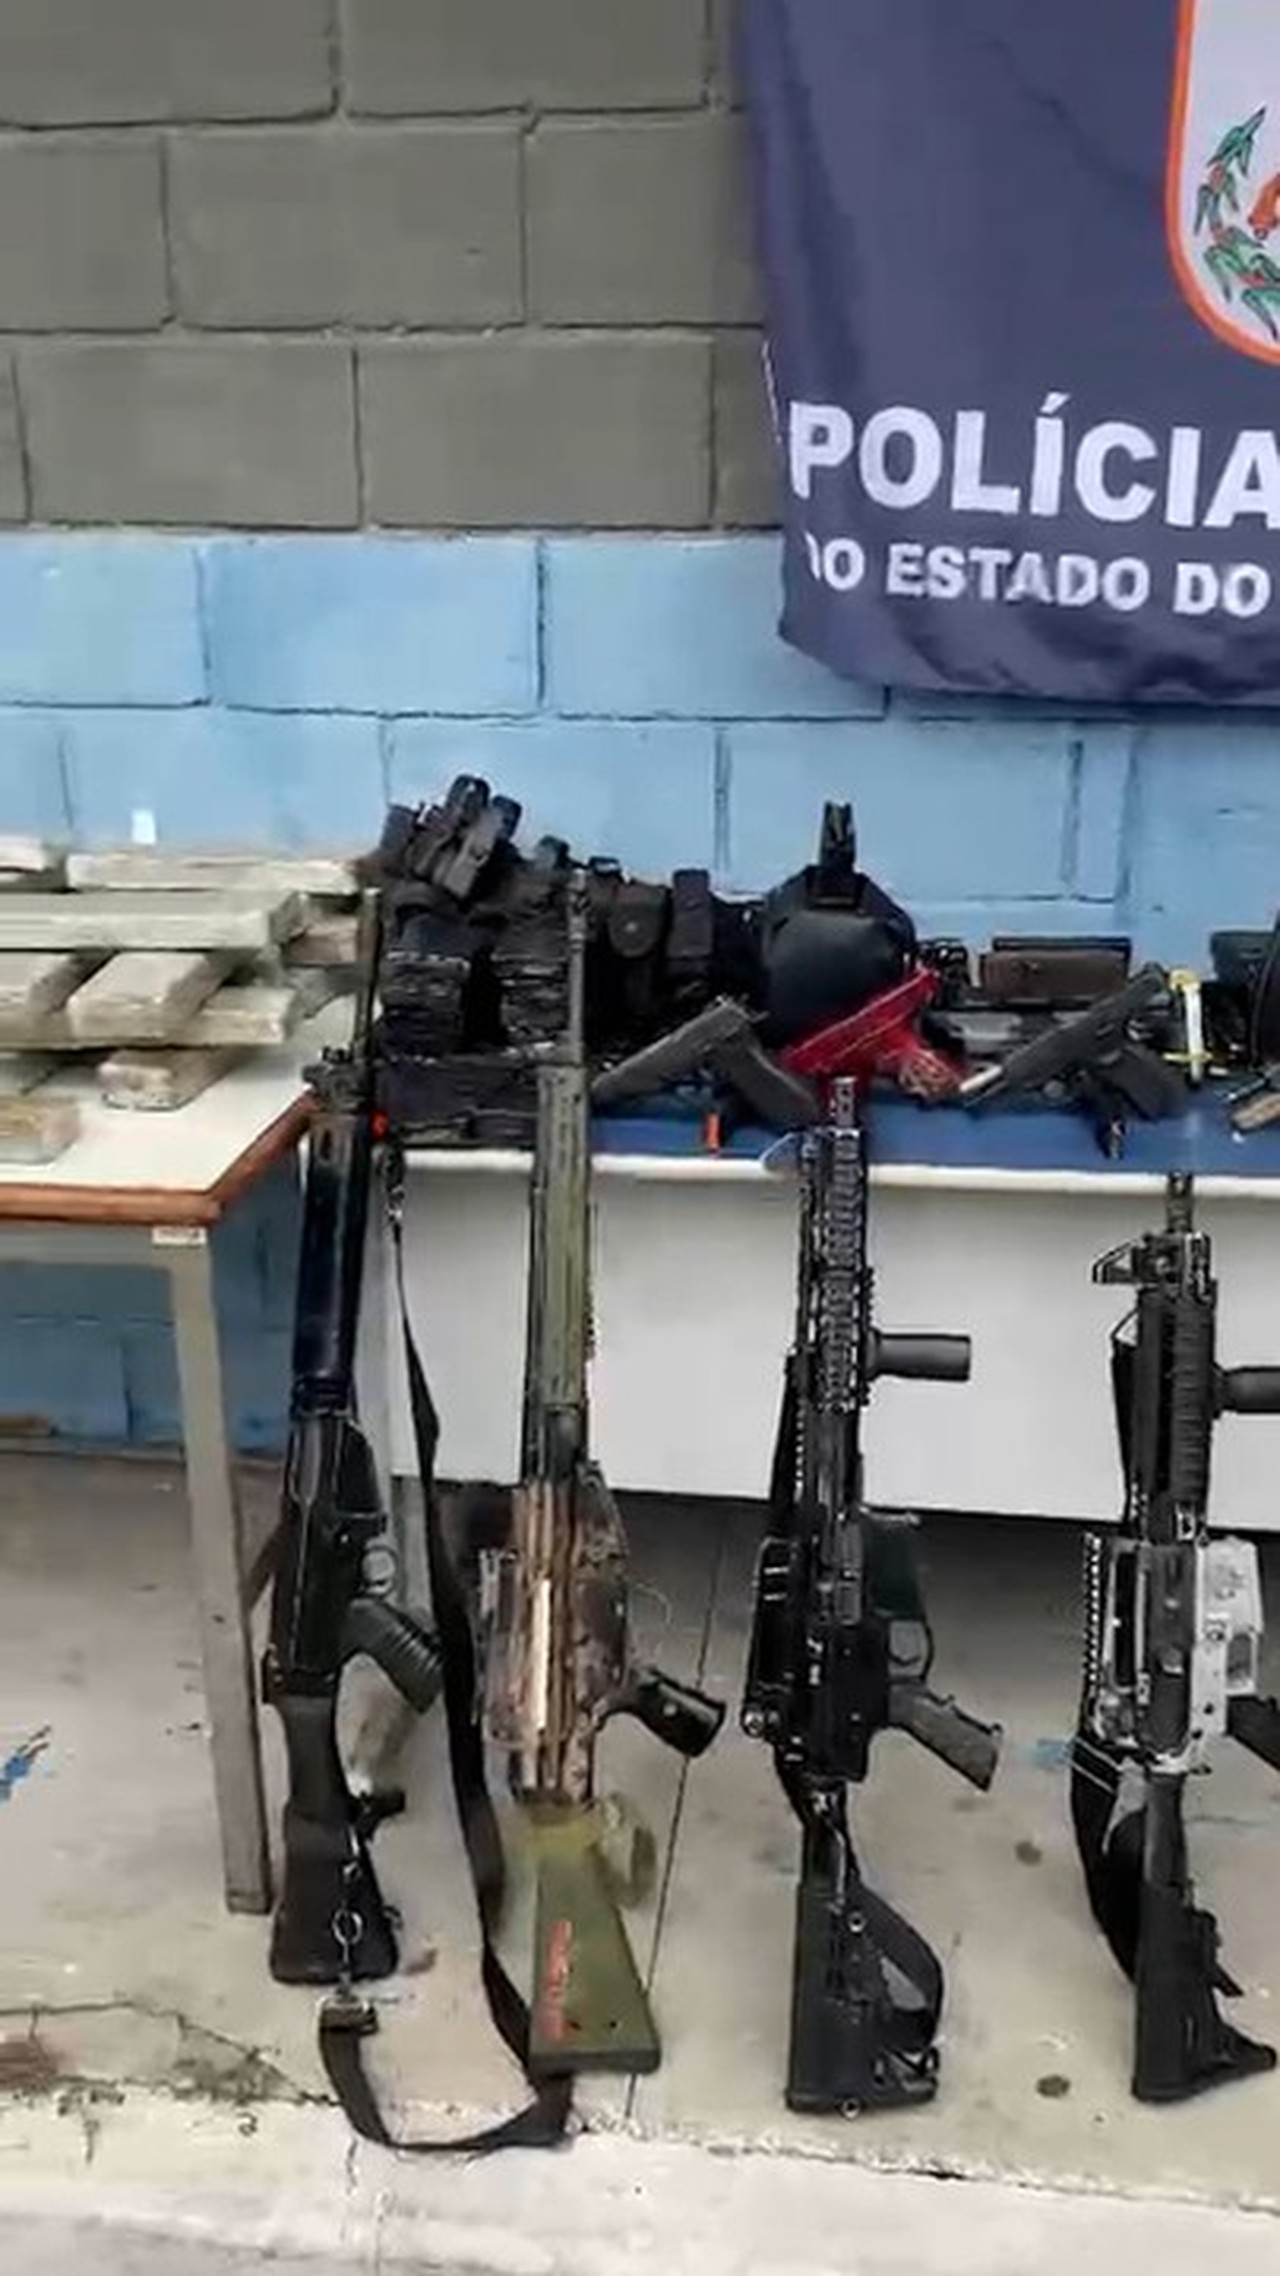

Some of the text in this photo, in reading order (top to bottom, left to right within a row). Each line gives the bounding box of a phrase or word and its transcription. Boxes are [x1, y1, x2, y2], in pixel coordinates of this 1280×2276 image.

[788, 391, 1280, 529] POLÍCIA
[804, 530, 1271, 618] O ESTADO DO
